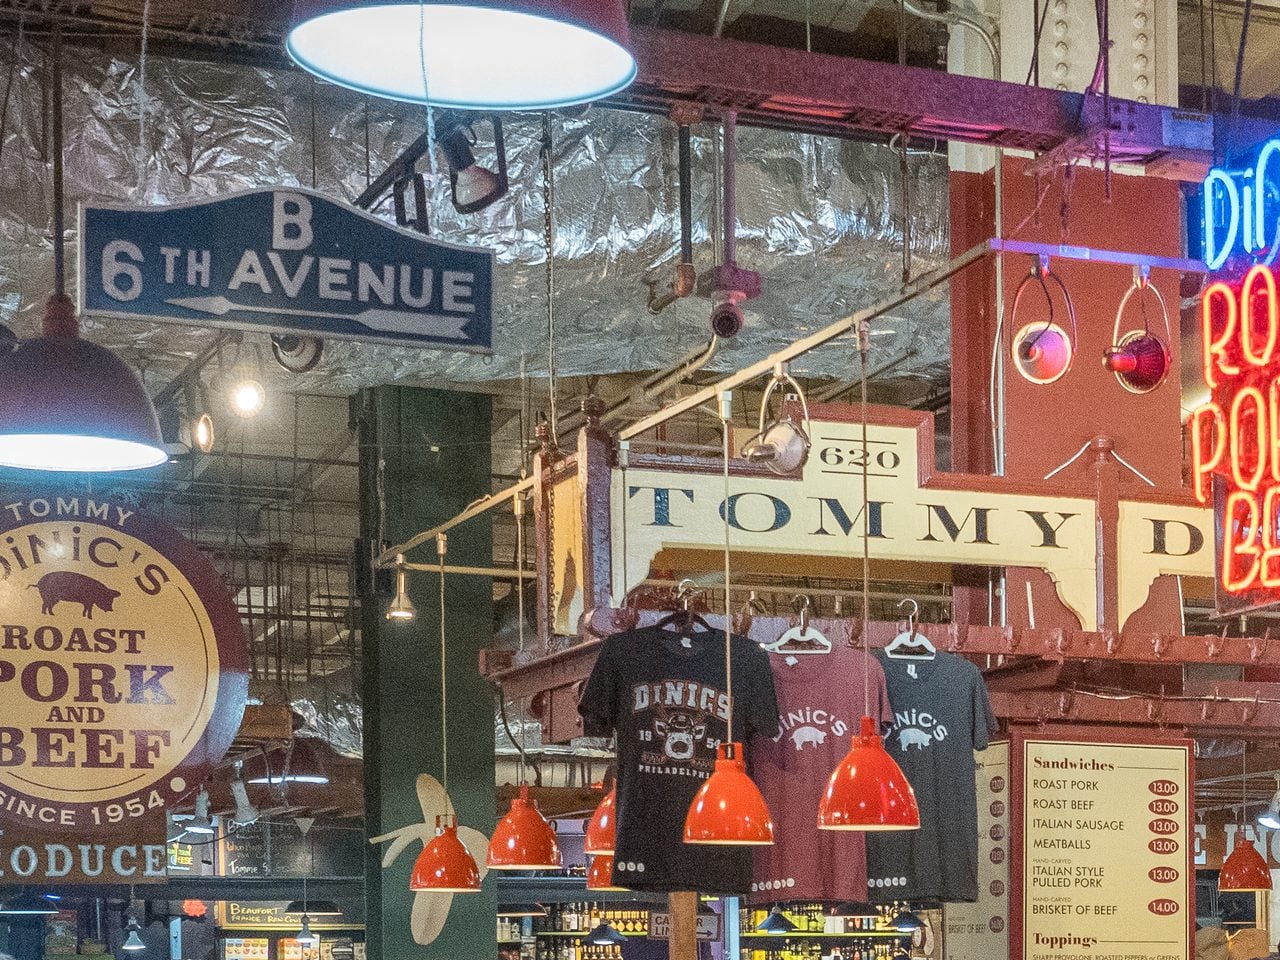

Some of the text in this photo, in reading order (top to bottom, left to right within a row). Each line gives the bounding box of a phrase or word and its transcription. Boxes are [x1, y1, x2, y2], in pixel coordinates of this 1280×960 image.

[271, 191, 314, 250] B
[101, 240, 476, 313] 6 TH AVENUE
[819, 447, 901, 470] 620
[5, 497, 134, 527] TOMMY
[629, 486, 1082, 549] TOMMY
[1, 625, 146, 654] ROAST
[46, 706, 105, 723] AND
[639, 730, 652, 741] 19
[1033, 757, 1114, 771] Sandwiches
[638, 765, 710, 779] PHILADELPHI
[1033, 779, 1099, 790] ROAST PORK
[1152, 782, 1177, 793] 13.00
[91, 789, 165, 825] 1954
[1033, 799, 1094, 810] ROAST BEEF
[1152, 802, 1176, 813] 13.00
[1033, 819, 1124, 830] ITALIAN SAUSAGE
[1152, 821, 1177, 832] 13.00
[1033, 839, 1091, 849] MEATBALLS
[1152, 841, 1177, 852] 13.00
[0, 844, 166, 877] ODUCE
[1033, 866, 1104, 877] ITALIAN STYLE
[1152, 870, 1177, 880] 13.00
[1033, 878, 1102, 888] PULLED PORK
[1033, 905, 1118, 916] BRISKET OF BEEF
[1152, 902, 1177, 913] 14.00
[1033, 933, 1098, 949] Toppings
